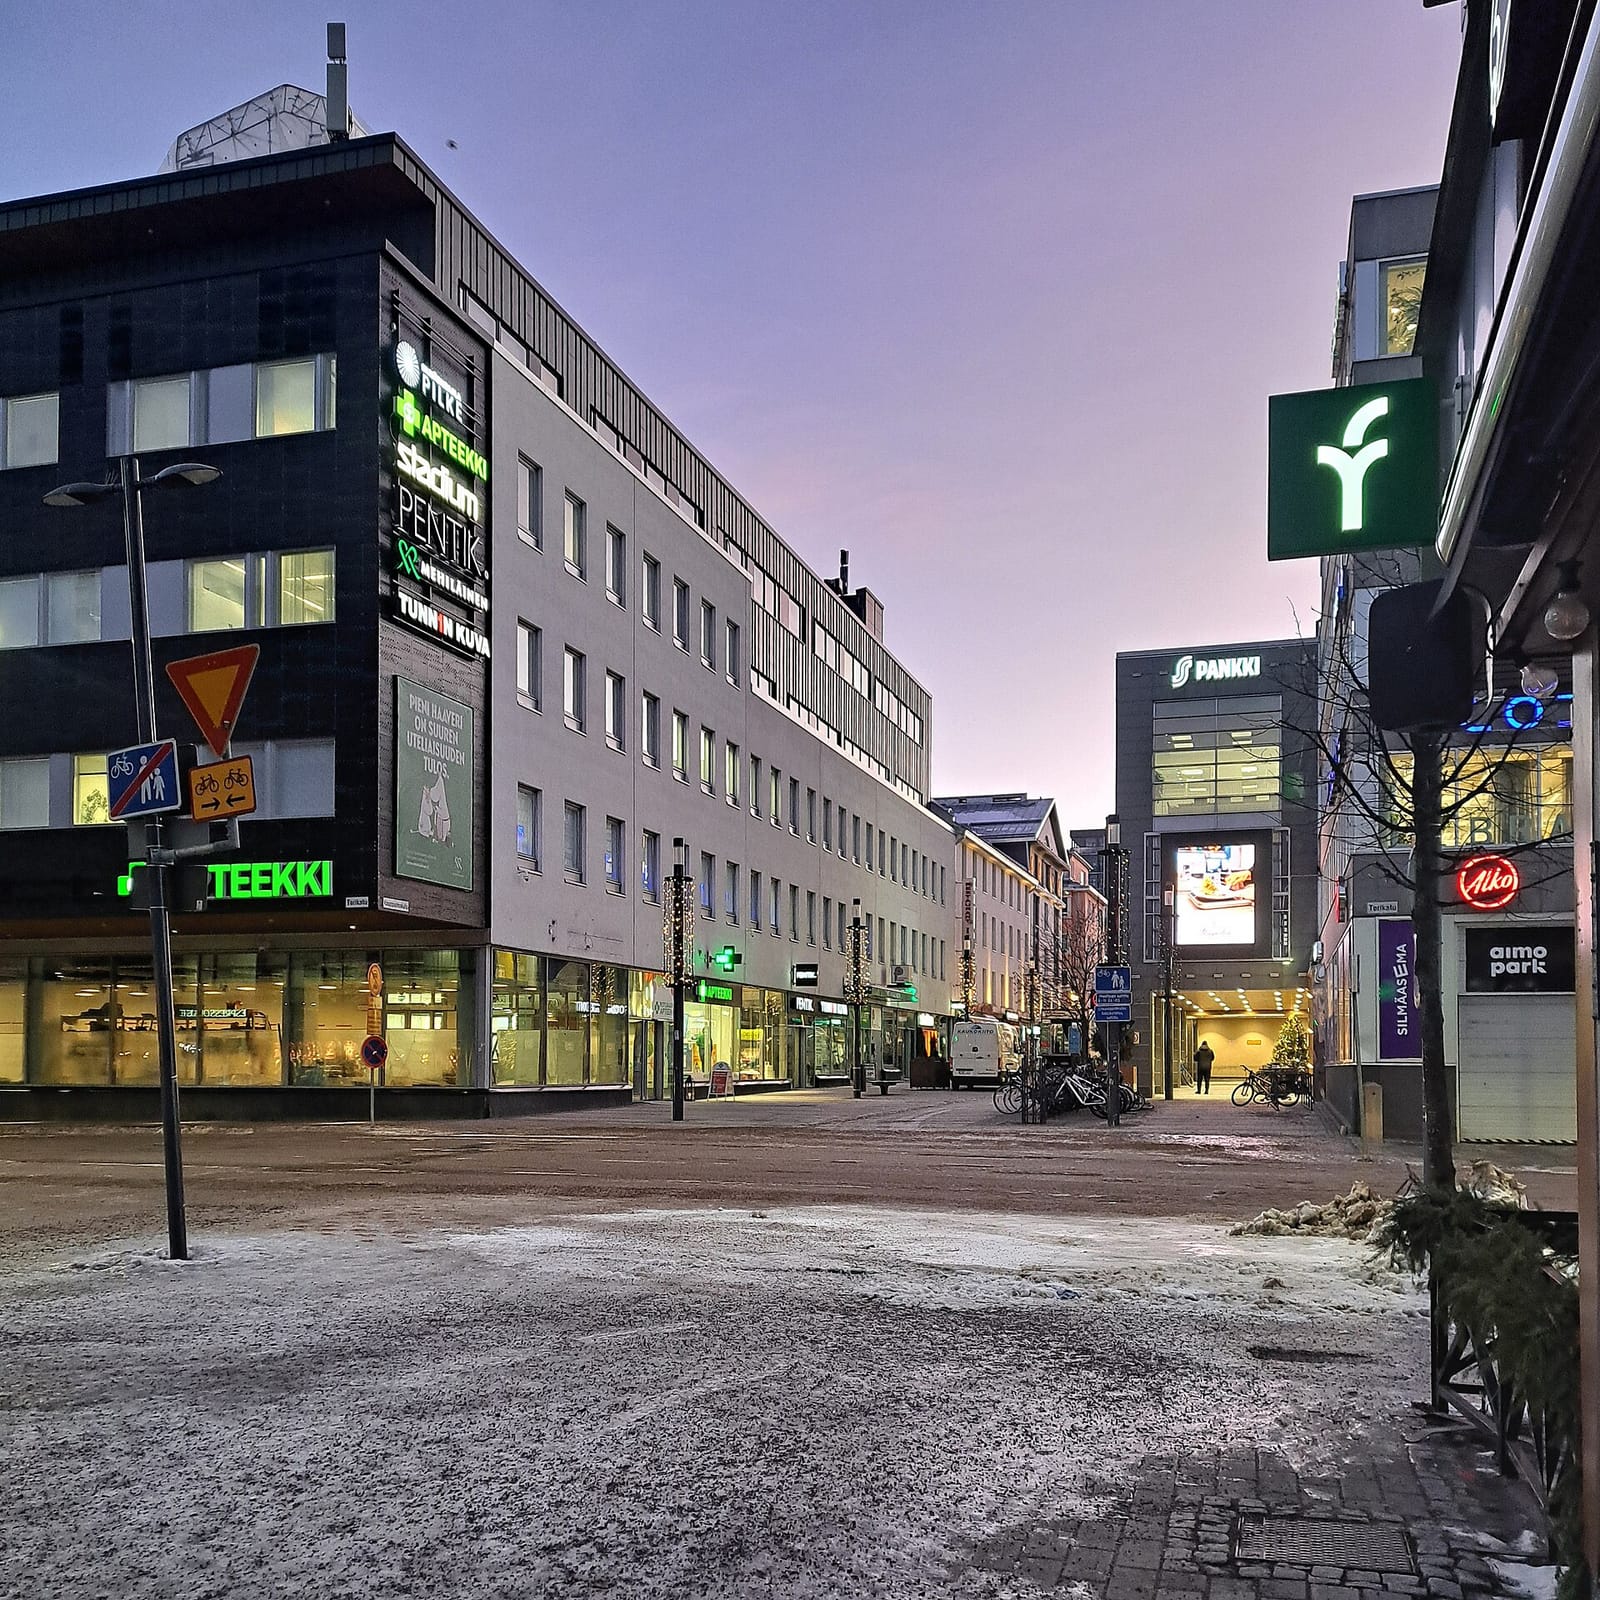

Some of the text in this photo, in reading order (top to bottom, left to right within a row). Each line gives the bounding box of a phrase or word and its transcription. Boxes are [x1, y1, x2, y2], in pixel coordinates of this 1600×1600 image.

[422, 371, 463, 424] PILKE
[422, 415, 487, 481] APTEEKKI
[400, 485, 482, 577] PENTIK
[455, 622, 491, 658] KUVA
[1195, 655, 1261, 680] PANKKI
[409, 694, 463, 730] PIENI HAAVERI
[407, 730, 465, 765] UTELIAISUUDEN
[414, 715, 459, 745] ON SUUREN
[207, 860, 333, 898] TEEKKI
[1466, 868, 1513, 893] Alko
[1369, 903, 1397, 912] Torikatu
[1490, 946, 1548, 959] aimo
[1490, 958, 1548, 977] park
[1393, 943, 1409, 1036] SILMÄASEMA
